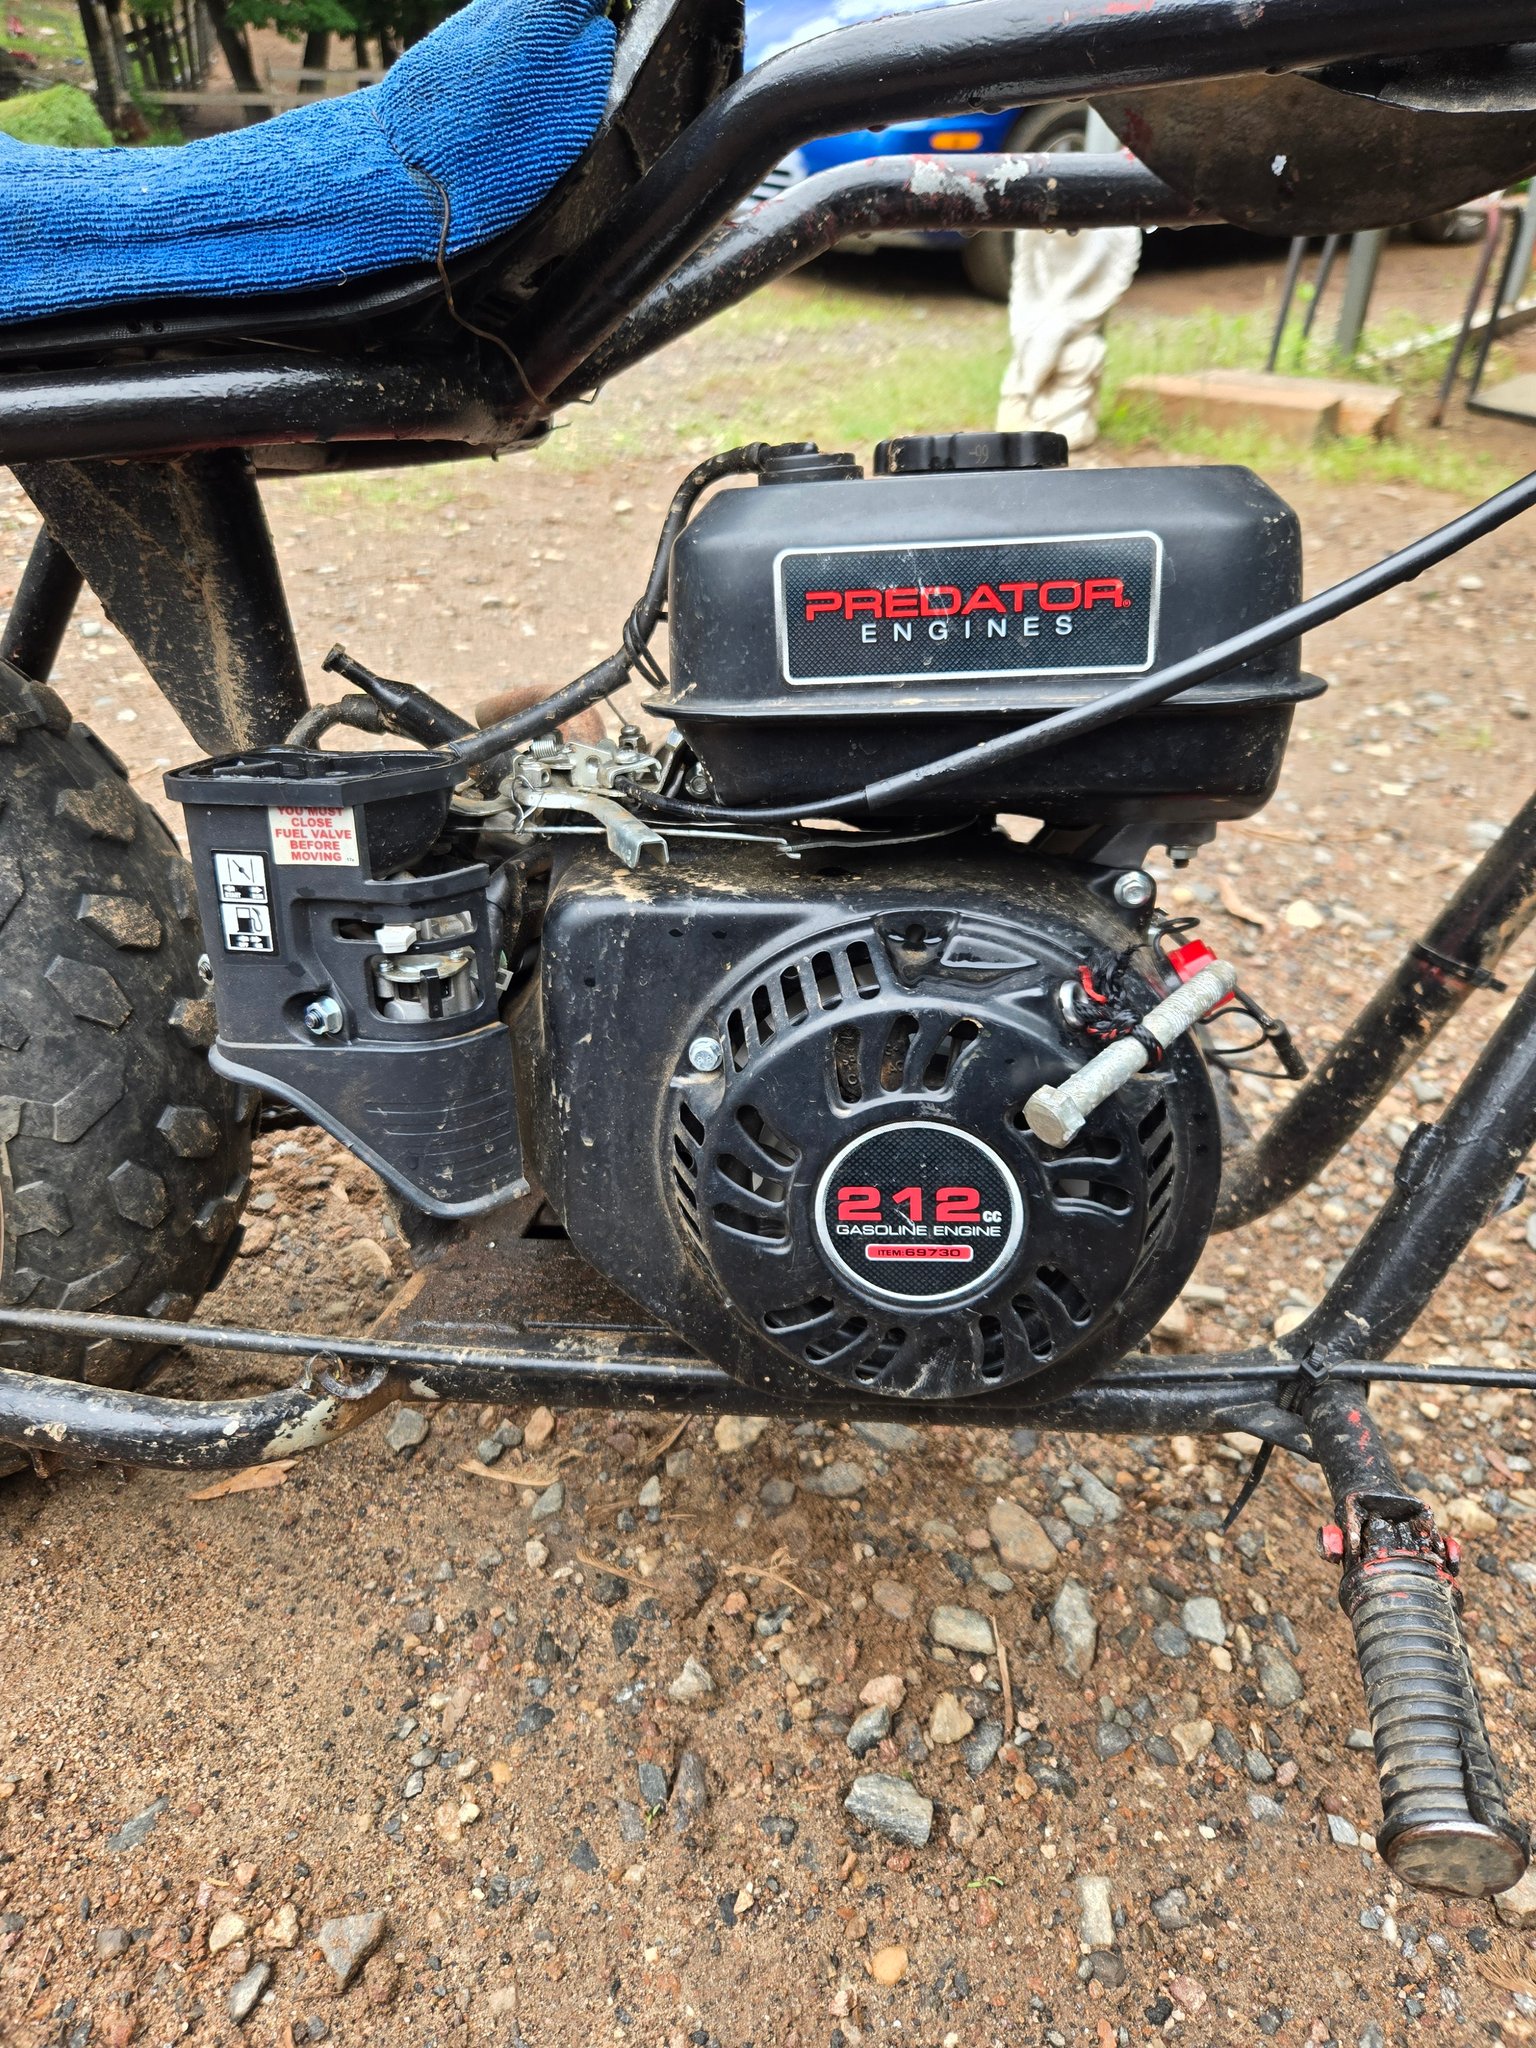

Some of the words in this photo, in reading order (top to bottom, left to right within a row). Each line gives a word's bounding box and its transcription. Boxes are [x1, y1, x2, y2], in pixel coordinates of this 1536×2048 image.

[805, 578, 1124, 622] PREDATOR
[861, 614, 1074, 645] ENGINES
[277, 806, 304, 816] YOU
[307, 806, 344, 817] MUST
[291, 817, 333, 828] CLOSE
[275, 828, 308, 839] FUEL
[311, 829, 352, 840] VALVE
[290, 840, 341, 851] BEFORE
[291, 851, 342, 862] MOVING
[836, 1224, 928, 1236] GASOLINE
[933, 1225, 1002, 1237] ENGINE
